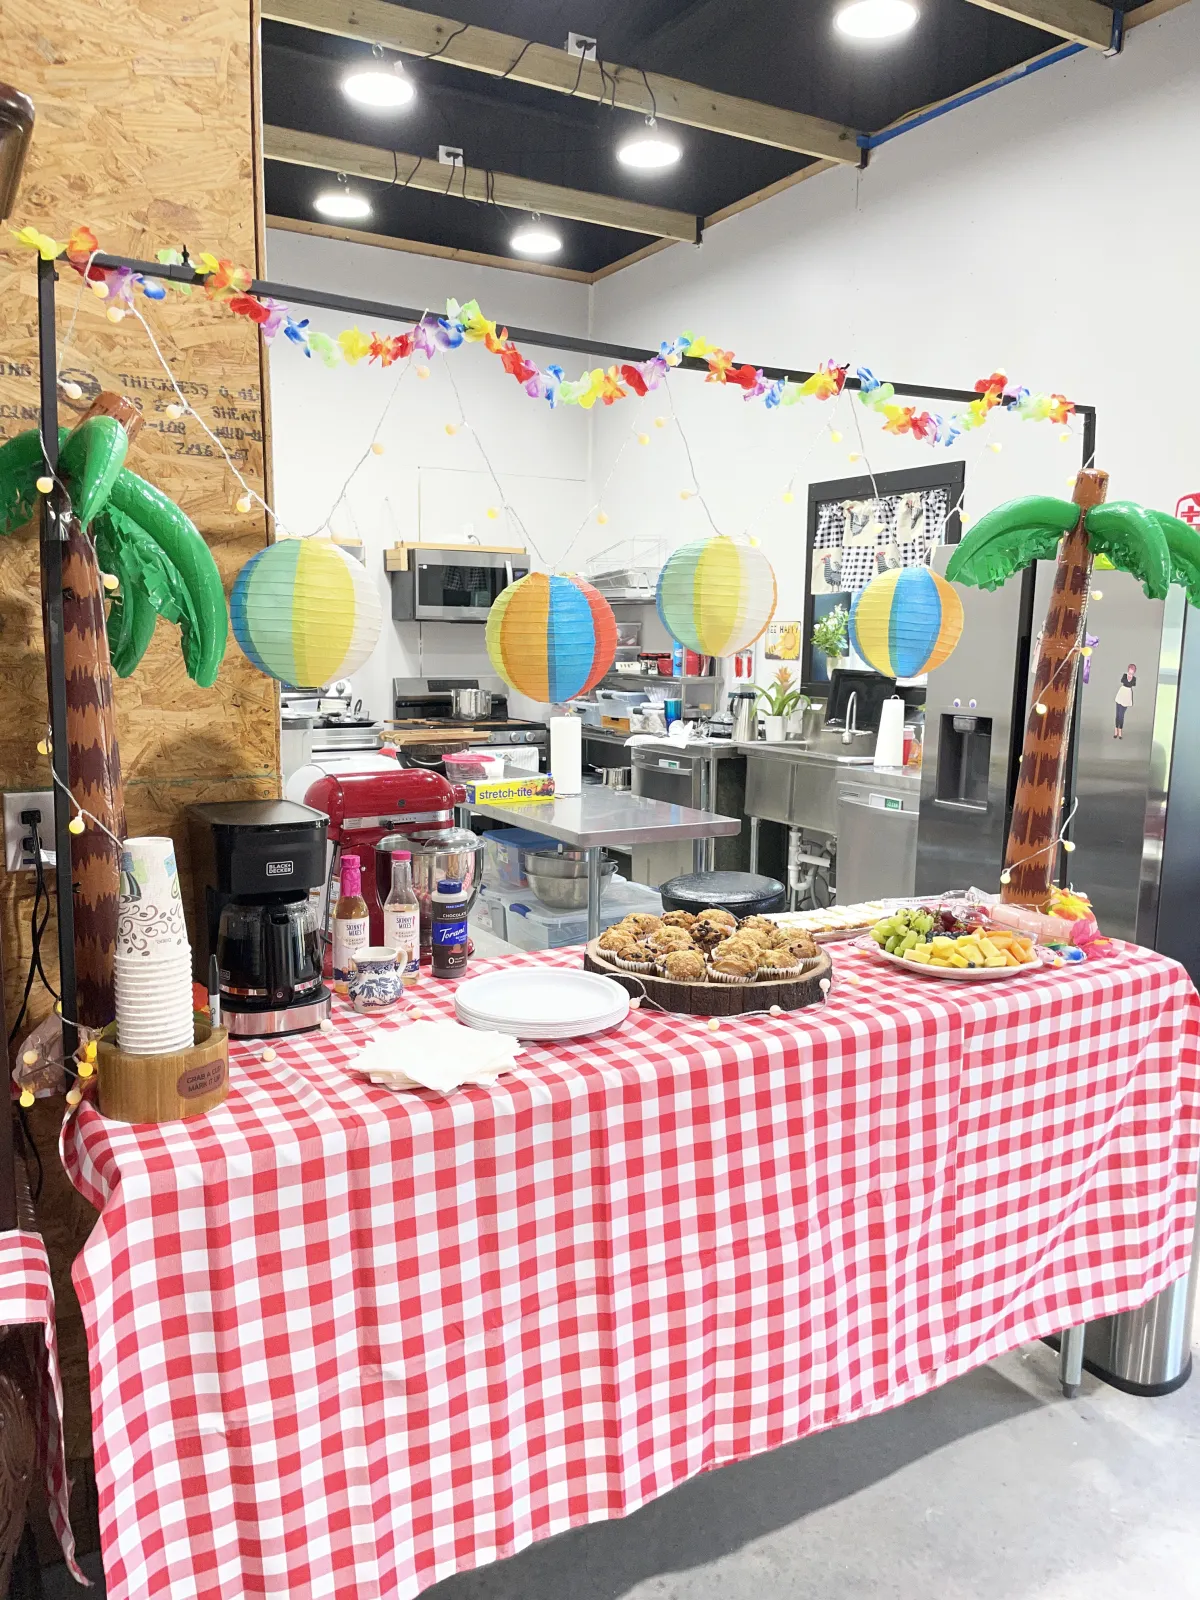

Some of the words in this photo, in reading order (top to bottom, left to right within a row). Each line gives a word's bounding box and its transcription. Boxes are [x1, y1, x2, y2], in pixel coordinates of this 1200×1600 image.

[118, 373, 209, 399] THICKNESS
[210, 405, 261, 423] SHEAT
[779, 624, 798, 634] HAPPY
[479, 787, 533, 800] stretch-tite
[439, 924, 466, 942] Torani
[186, 1073, 206, 1084] GRAB
[188, 1081, 208, 1092] MARK
